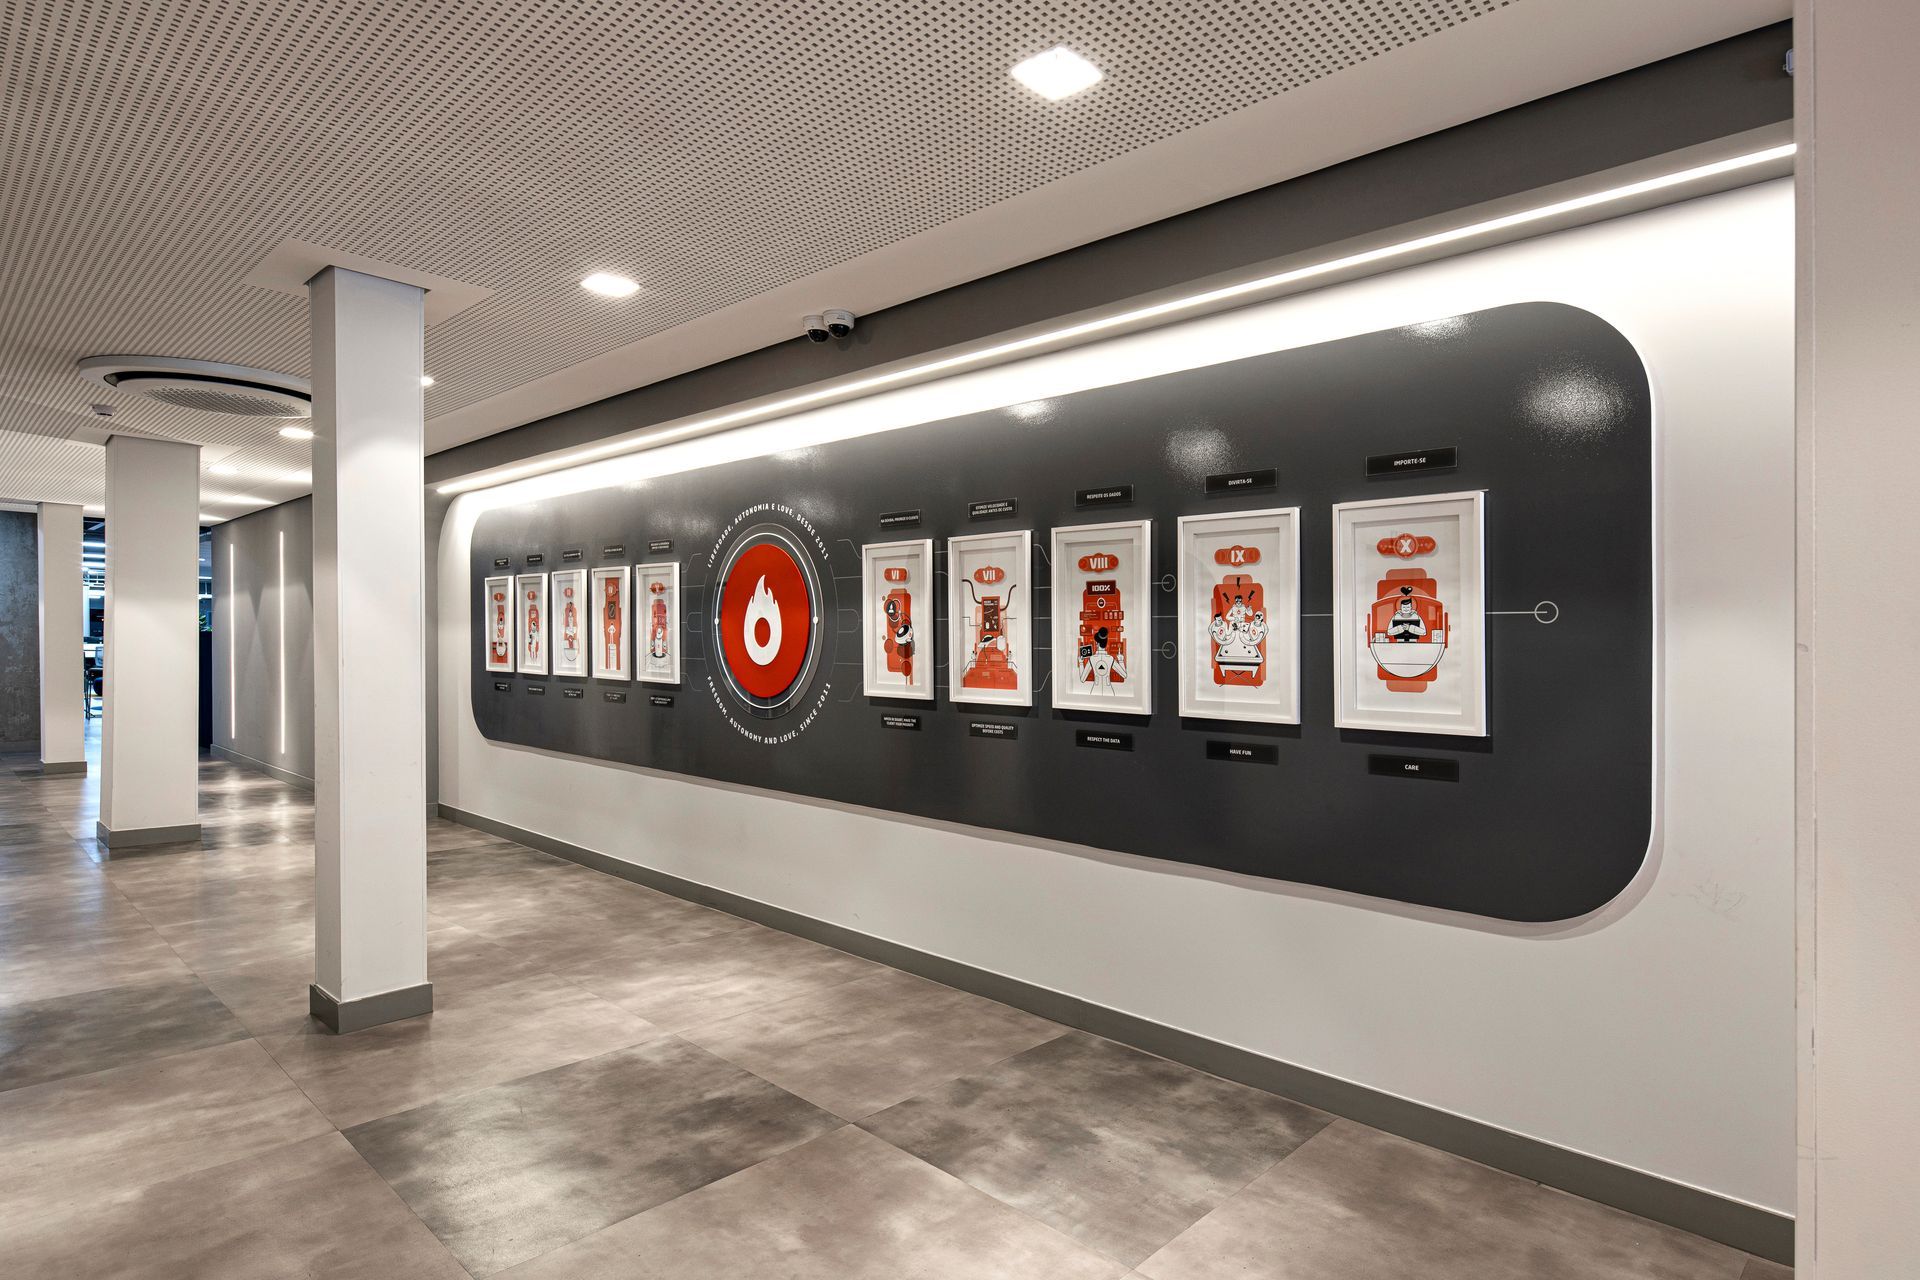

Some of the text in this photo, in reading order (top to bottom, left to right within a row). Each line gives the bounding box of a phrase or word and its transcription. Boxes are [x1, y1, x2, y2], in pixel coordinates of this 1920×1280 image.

[1393, 457, 1426, 466] IMPORTE-SE
[707, 525, 734, 568] LIBERDADE,
[734, 503, 769, 525] AUTONOMIA
[777, 503, 795, 518] LOVE,
[796, 513, 815, 536] DESDE
[815, 536, 829, 560] 2011
[1400, 539, 1412, 553] X
[1231, 550, 1245, 563] IX
[1089, 557, 1109, 570] VIII
[891, 570, 900, 580] VI
[982, 570, 996, 581] VII
[1091, 584, 1111, 592] 100%
[707, 675, 728, 719] FREEDOM,
[729, 717, 762, 743] AUTONOMY
[780, 730, 799, 743] LOVE,
[800, 708, 817, 732] SINCE
[816, 682, 831, 708] 2011
